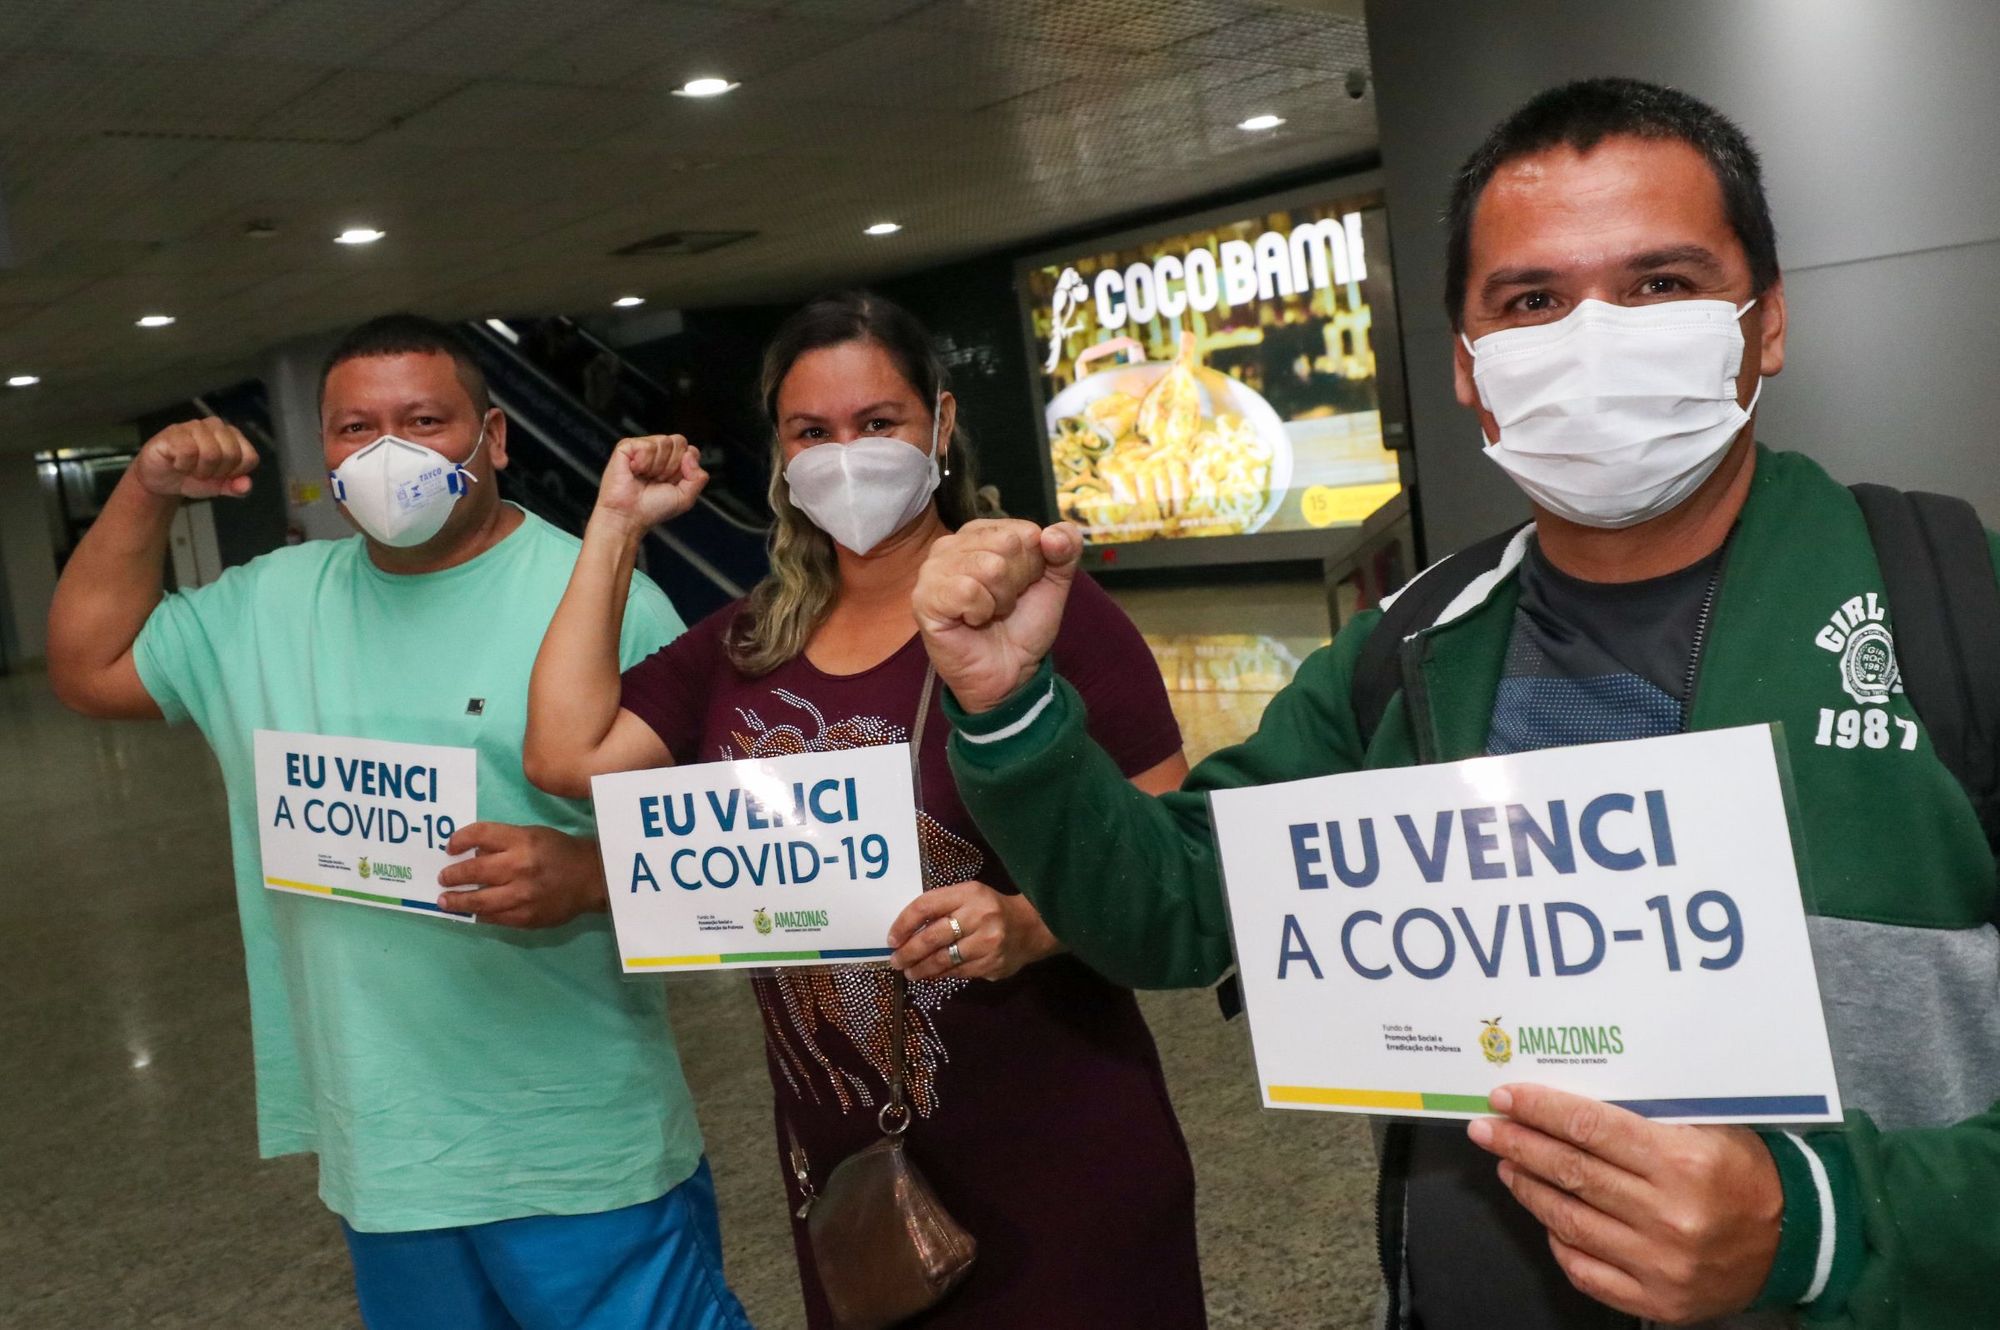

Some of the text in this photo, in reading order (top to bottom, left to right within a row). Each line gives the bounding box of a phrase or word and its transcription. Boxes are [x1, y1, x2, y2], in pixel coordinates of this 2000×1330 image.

[1814, 707, 1918, 751] 1987
[286, 752, 437, 803] EU VENCI
[273, 795, 455, 851] A COVID-19
[639, 793, 696, 838] EU
[630, 834, 889, 893] A COVID-19
[1289, 790, 1677, 890] EU VENCI
[373, 862, 412, 880] AMAZONAS
[774, 910, 829, 928] AMAZONAS
[1277, 890, 1745, 981] A COVID-19
[1518, 1025, 1624, 1055] AMAZONAS
